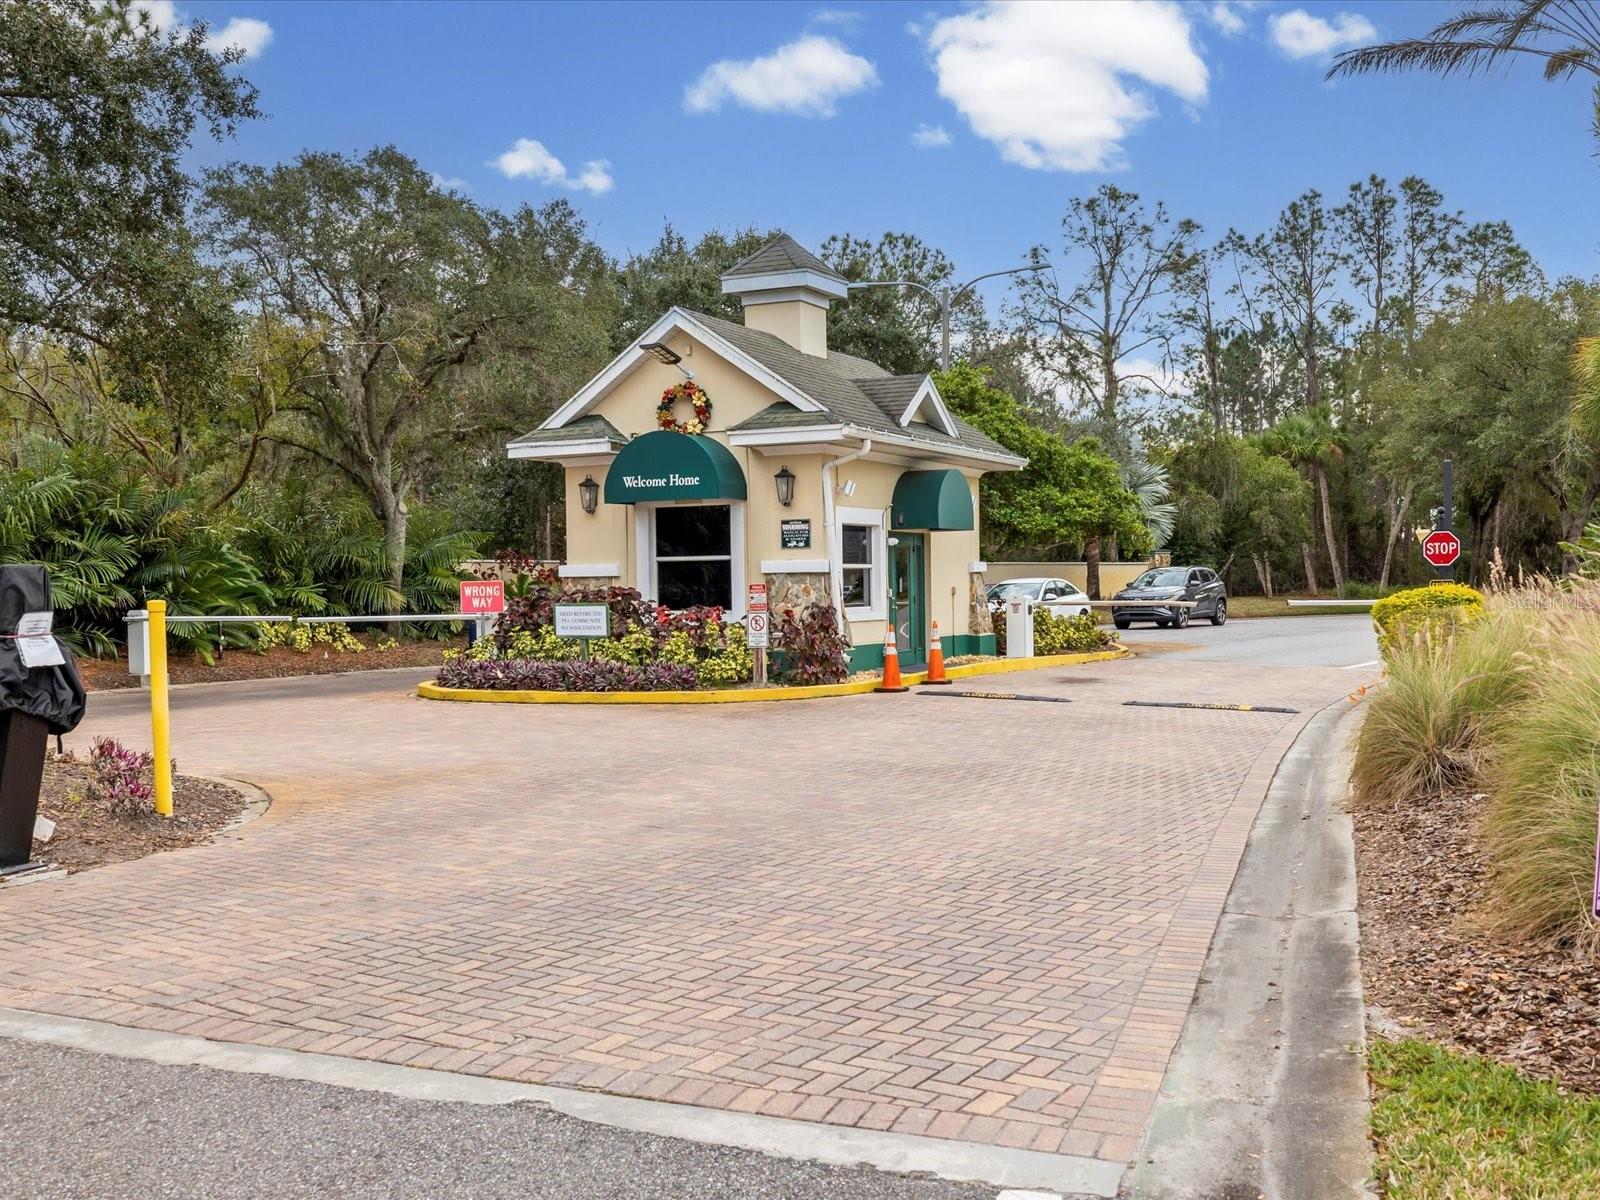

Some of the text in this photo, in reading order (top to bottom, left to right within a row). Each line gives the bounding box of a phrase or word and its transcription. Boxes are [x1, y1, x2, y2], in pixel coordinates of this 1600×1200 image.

[622, 473, 700, 488] Welcome Home
[1426, 542, 1457, 555] STOP
[464, 585, 501, 597] WRONG
[472, 597, 493, 608] WAY
